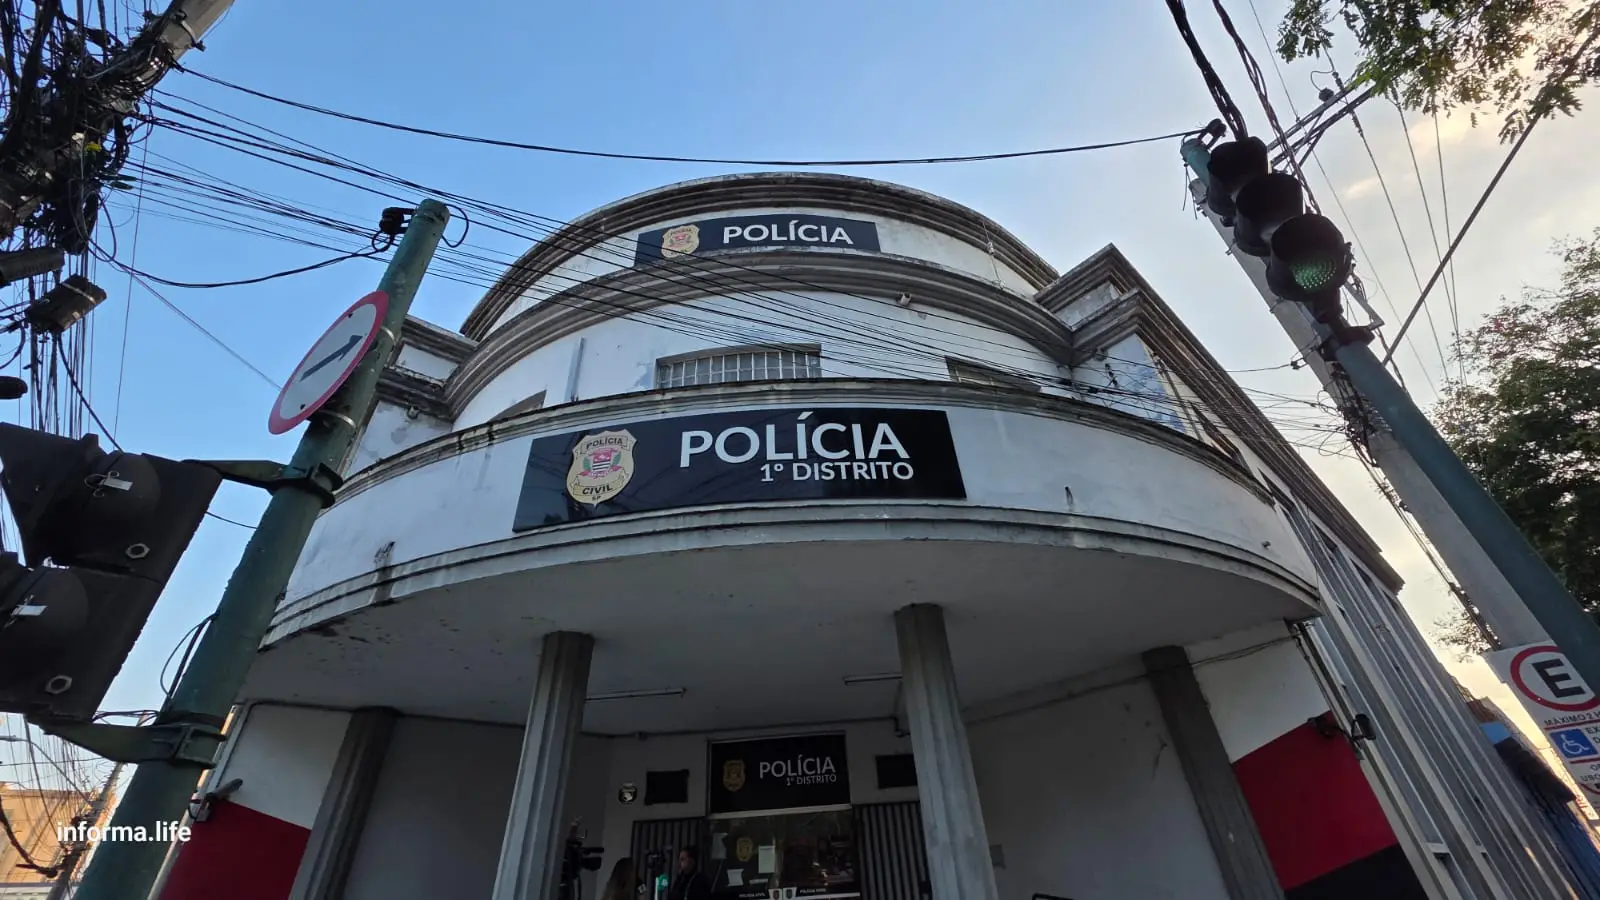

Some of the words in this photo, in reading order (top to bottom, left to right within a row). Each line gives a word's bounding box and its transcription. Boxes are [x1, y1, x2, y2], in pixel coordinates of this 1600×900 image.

[723, 220, 854, 244] POLÍCIA
[586, 437, 623, 450] POLÍCIA
[680, 411, 910, 468] POLÍCIA
[792, 462, 914, 482] DISTRITO
[582, 484, 612, 495] CIVIL
[1532, 658, 1586, 698] E
[759, 754, 836, 779] POLÍCIA
[797, 774, 837, 784] DISTRITO
